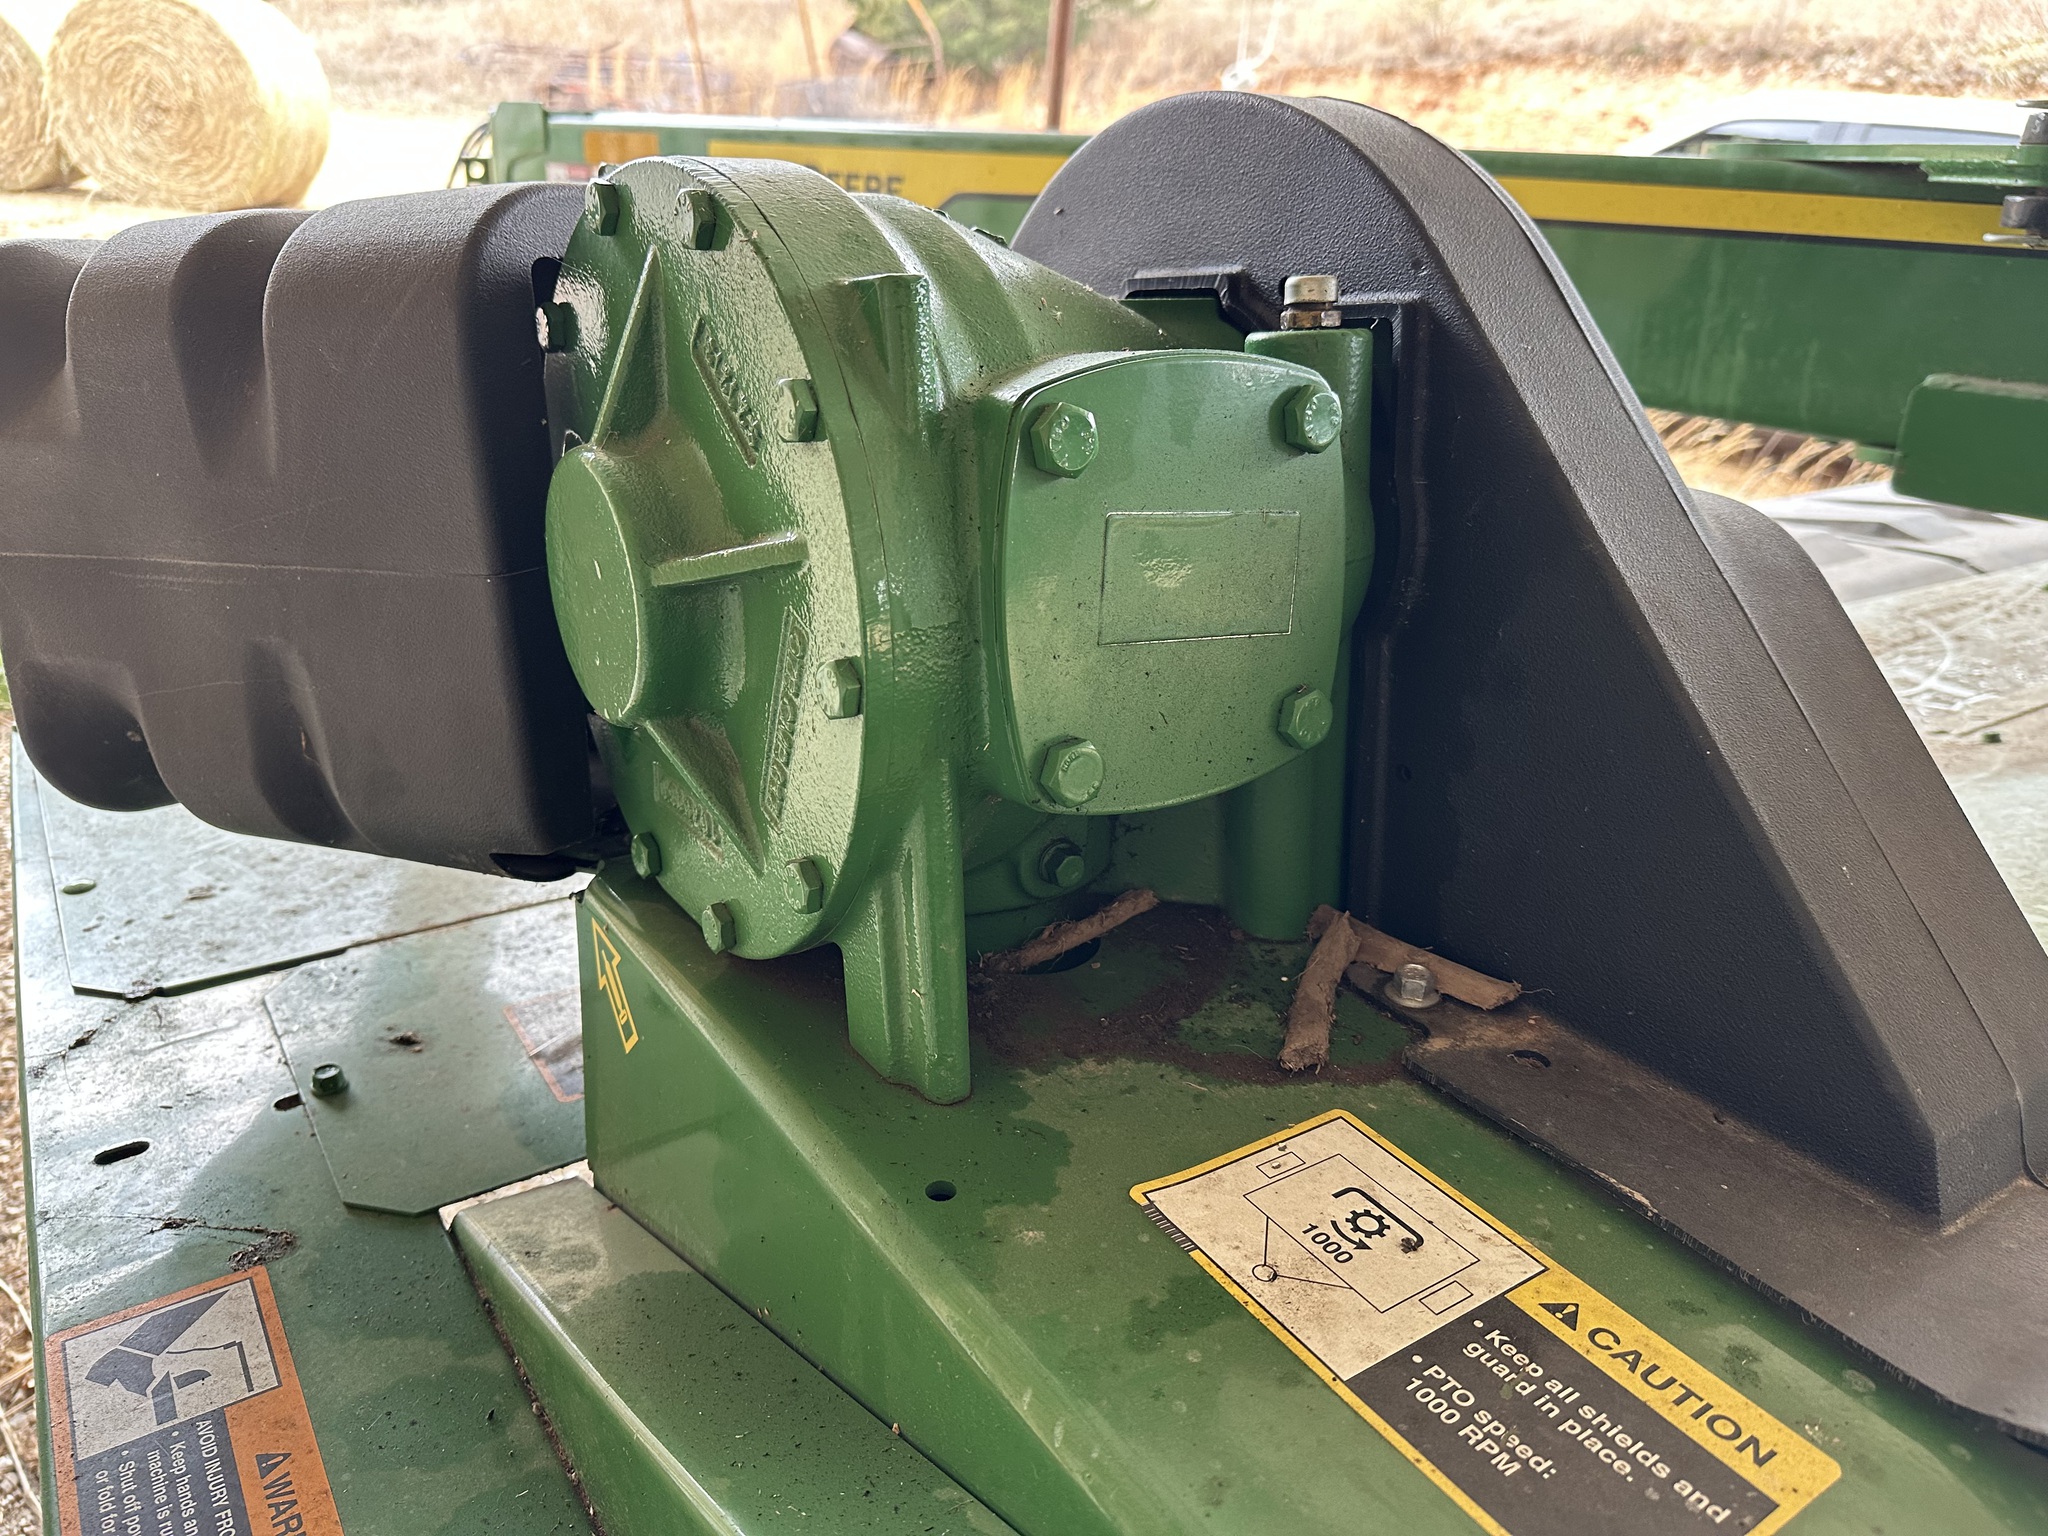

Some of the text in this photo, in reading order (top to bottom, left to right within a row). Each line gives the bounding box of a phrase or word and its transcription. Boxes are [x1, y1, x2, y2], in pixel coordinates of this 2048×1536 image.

[1302, 1223, 1353, 1264] 1000
[1423, 1364, 1557, 1479] PTO speed:
[1463, 1342, 1634, 1482] guard in place.
[1588, 1327, 1777, 1468] CAUTION
[196, 1420, 218, 1458] AVOID
[1405, 1377, 1522, 1477] 1000 RPM
[1485, 1329, 1732, 1524] Keep all shields and
[118, 1460, 137, 1493] Shut
[147, 1449, 170, 1504] machine
[169, 1441, 186, 1475] Keep
[204, 1458, 230, 1507] INJURY
[95, 1470, 118, 1534] or fold for
[122, 1494, 142, 1513] off
[156, 1503, 173, 1519] is
[176, 1474, 198, 1518] hands
[263, 1471, 306, 1536] WAR
